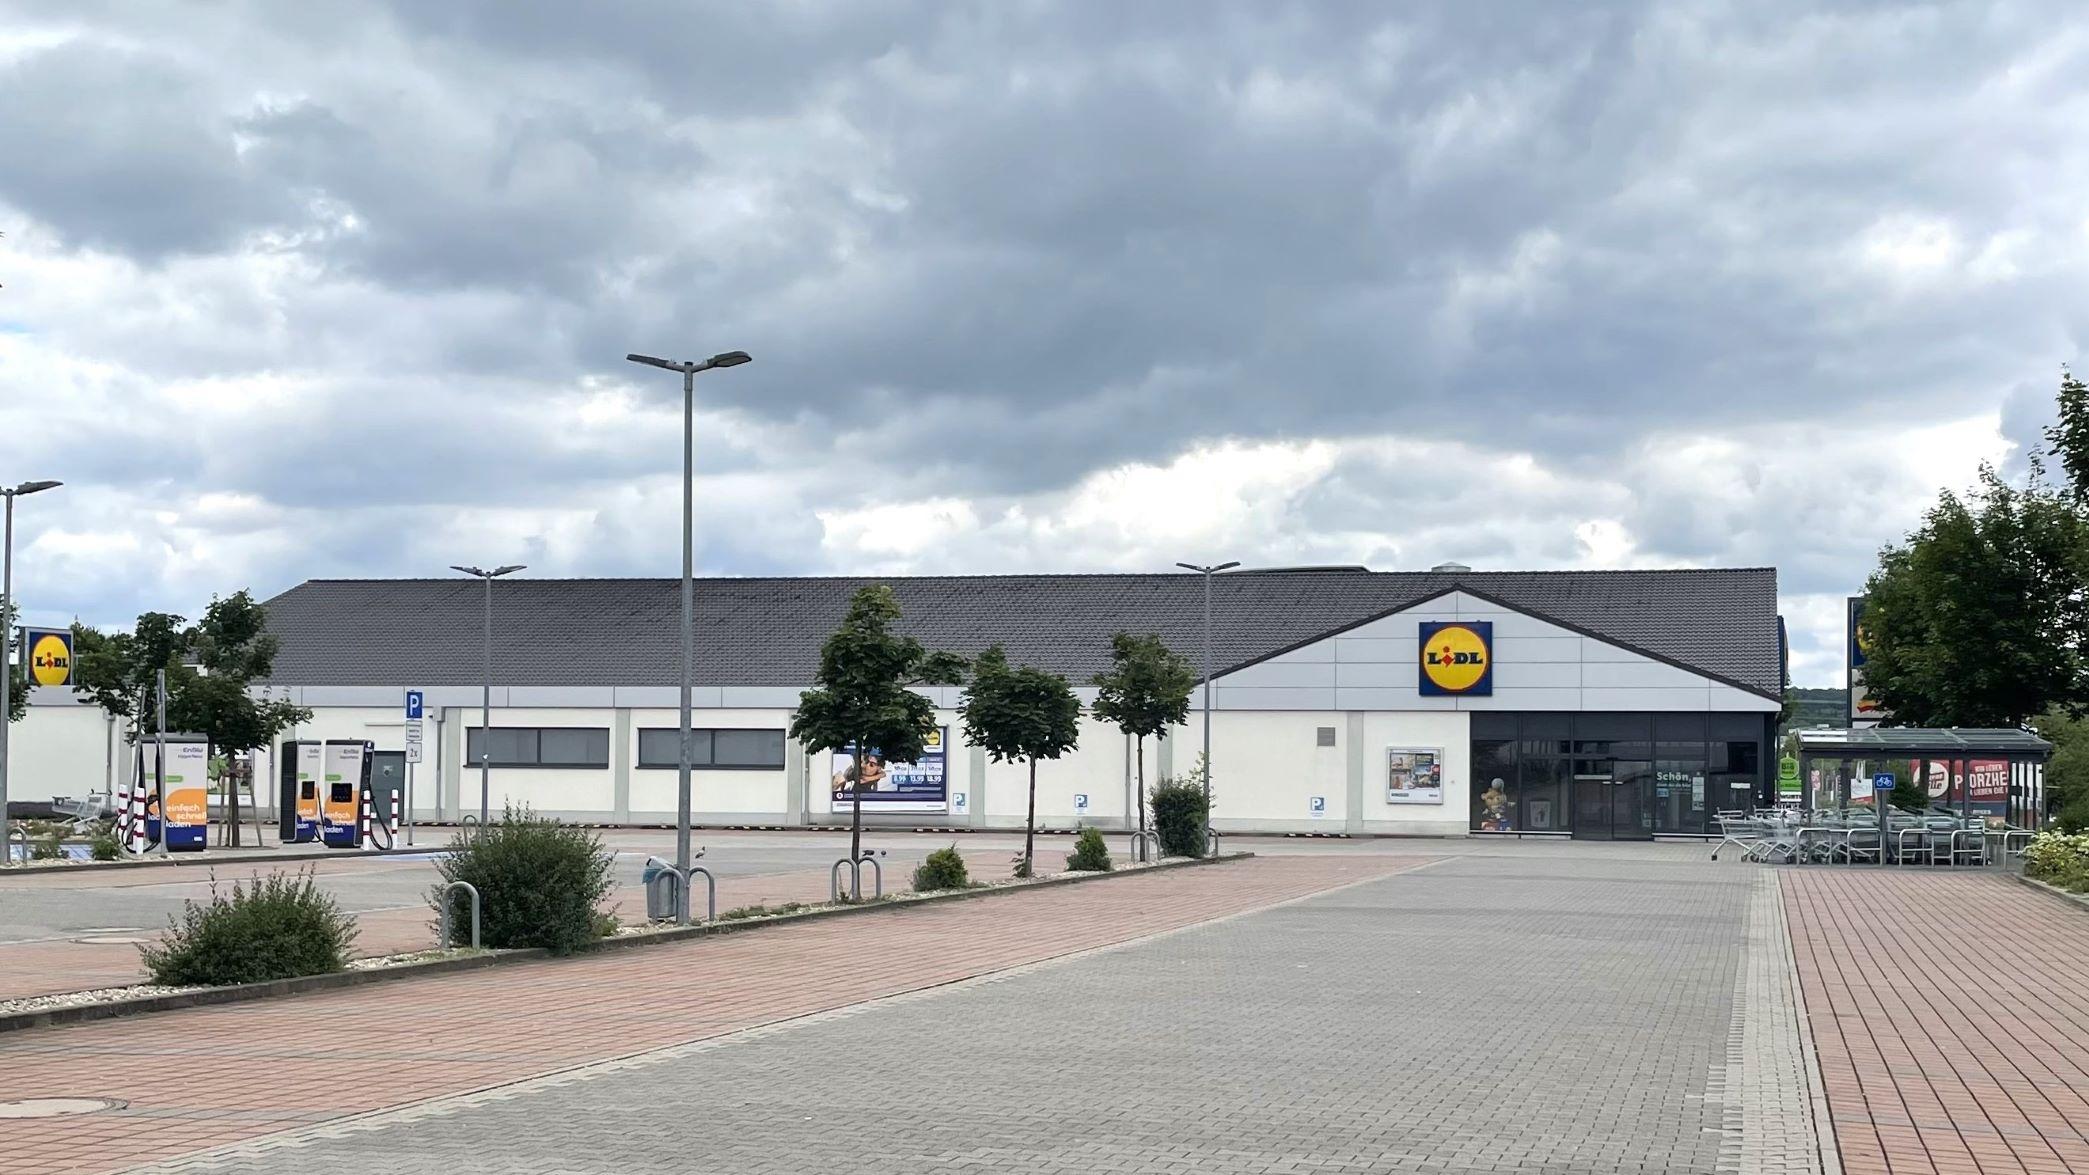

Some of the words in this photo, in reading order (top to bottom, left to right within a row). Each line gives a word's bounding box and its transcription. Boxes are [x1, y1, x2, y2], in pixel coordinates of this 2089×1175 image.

[409, 694, 419, 715] P
[1656, 771, 1691, 782] Schön,
[166, 803, 200, 812] einfach
